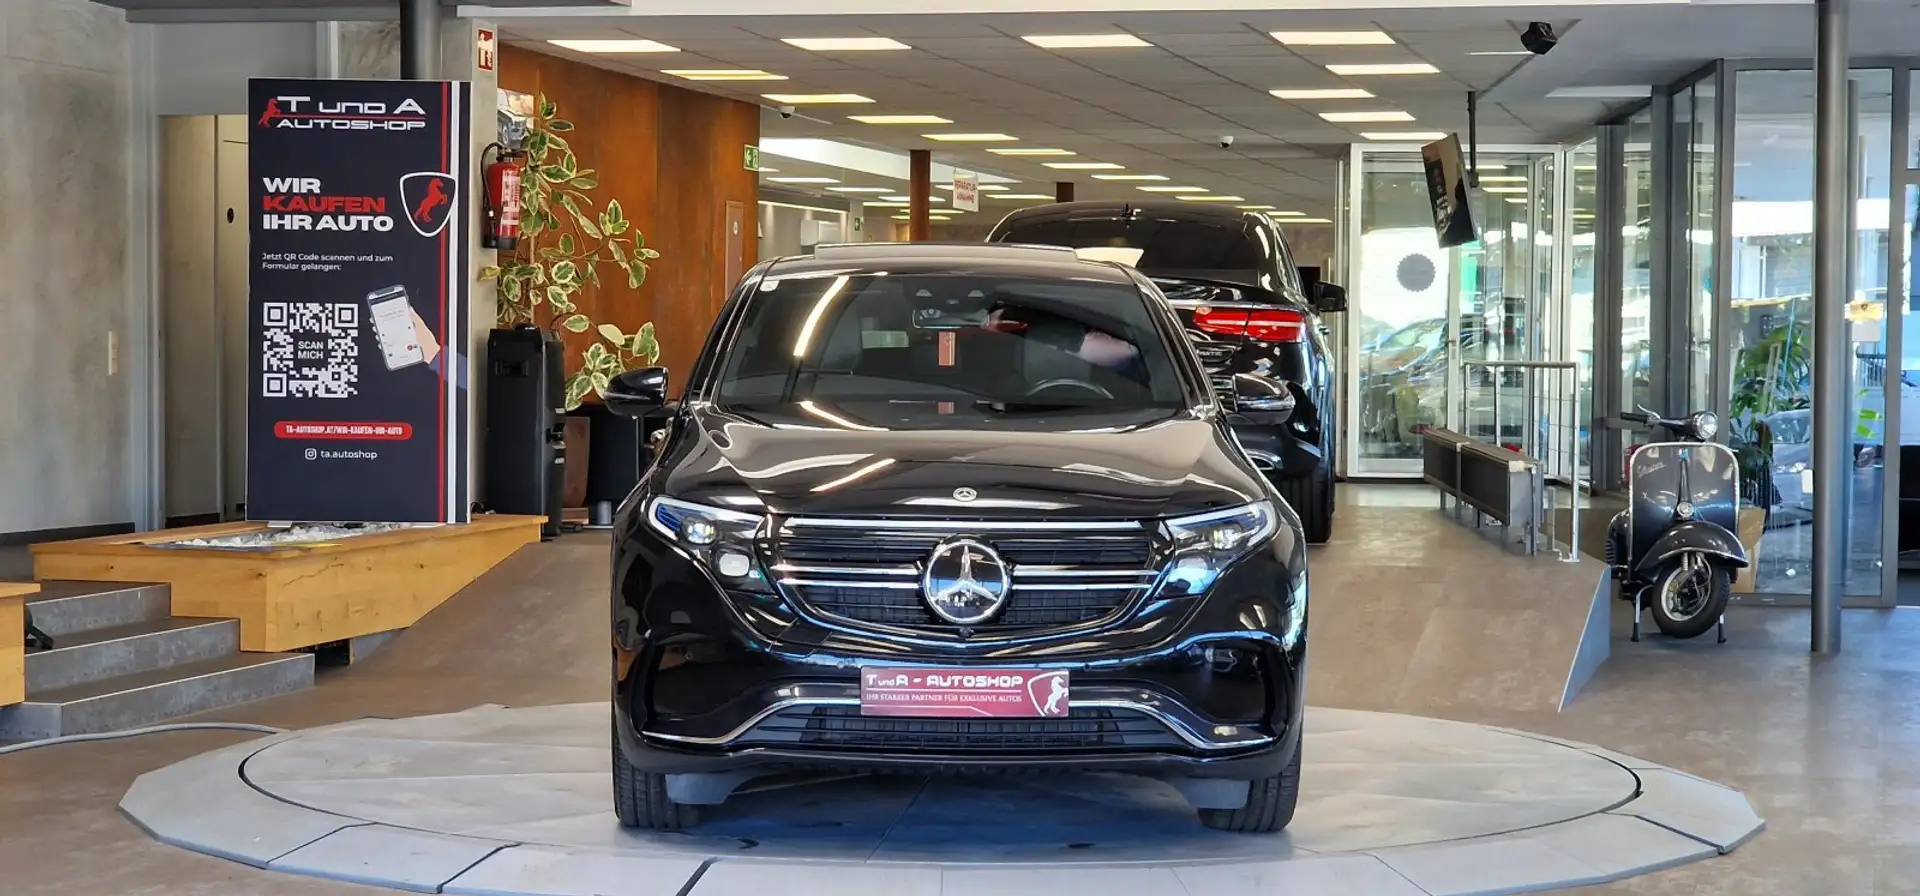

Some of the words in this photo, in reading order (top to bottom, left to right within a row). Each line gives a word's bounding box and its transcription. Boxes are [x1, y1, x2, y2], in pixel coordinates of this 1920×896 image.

[277, 96, 310, 112] T
[393, 99, 426, 114] A
[277, 119, 426, 130] AUTOSHOP
[263, 178, 321, 193] WIR
[263, 196, 385, 212] KAUFEN
[263, 214, 312, 230] IHR
[316, 215, 394, 231] AUTO
[284, 253, 296, 261] QR
[298, 253, 319, 261] Code
[301, 264, 342, 272] gelangen:
[297, 341, 324, 349] SCAN
[297, 351, 324, 359] MICH
[320, 449, 378, 460] ta.autoshop
[866, 674, 878, 685] T
[895, 674, 909, 687] A
[926, 675, 1023, 688] AUTOSHOP
[880, 693, 910, 701] STARKER
[911, 694, 943, 702] PARTNER
[944, 693, 958, 702] FÜR
